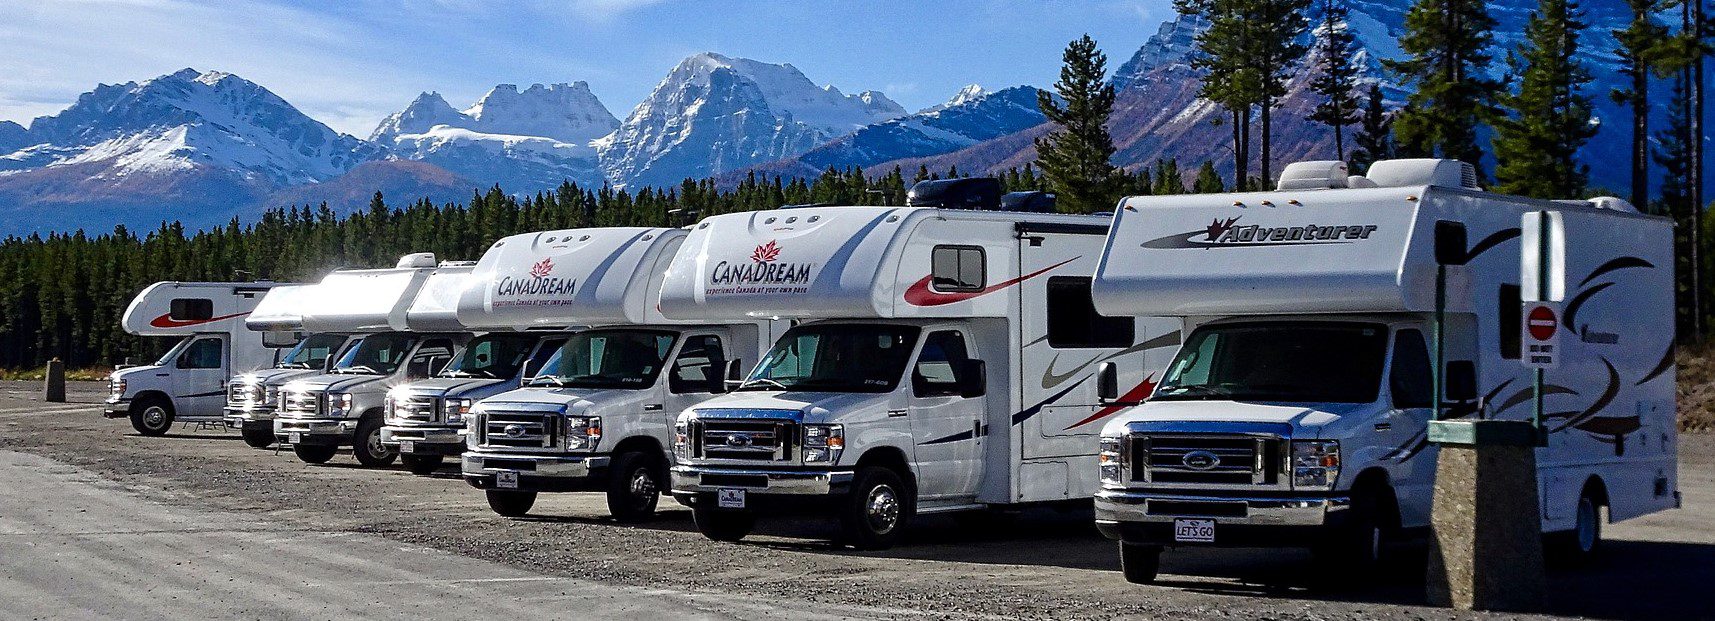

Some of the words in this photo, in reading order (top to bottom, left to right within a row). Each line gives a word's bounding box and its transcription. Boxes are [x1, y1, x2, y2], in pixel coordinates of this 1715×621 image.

[1219, 224, 1377, 243] Adventurer
[706, 287, 735, 295] experience
[736, 286, 756, 294] Canada
[765, 287, 778, 295] your
[793, 287, 808, 295] pace
[1177, 526, 1198, 536] LET'S
[1199, 526, 1214, 537] GO
